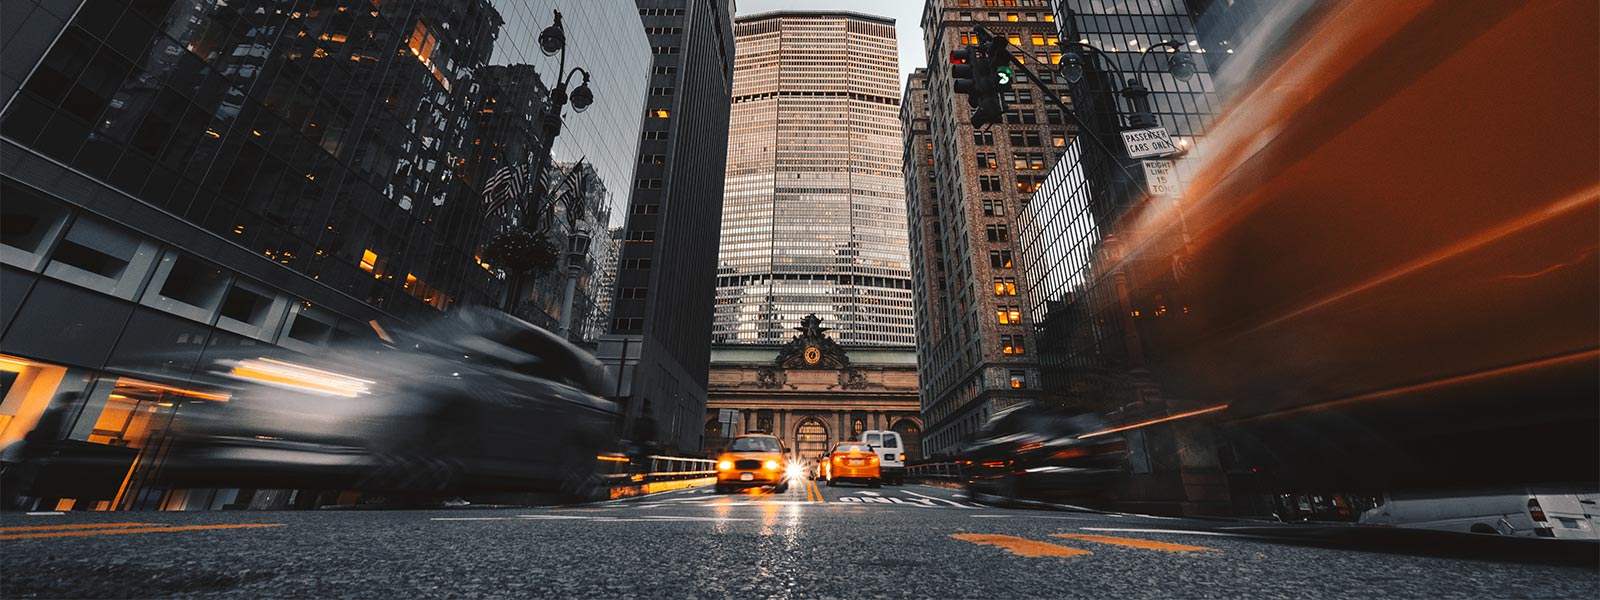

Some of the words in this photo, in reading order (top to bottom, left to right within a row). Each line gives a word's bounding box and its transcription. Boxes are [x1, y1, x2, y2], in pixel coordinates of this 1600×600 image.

[1125, 131, 1167, 143] PASSENGER
[1130, 144, 1149, 153] CARS
[1152, 142, 1171, 150] ONLY
[1144, 161, 1171, 169] WEIGHT
[1152, 185, 1177, 193] TONS
[839, 496, 939, 507] ONLY
